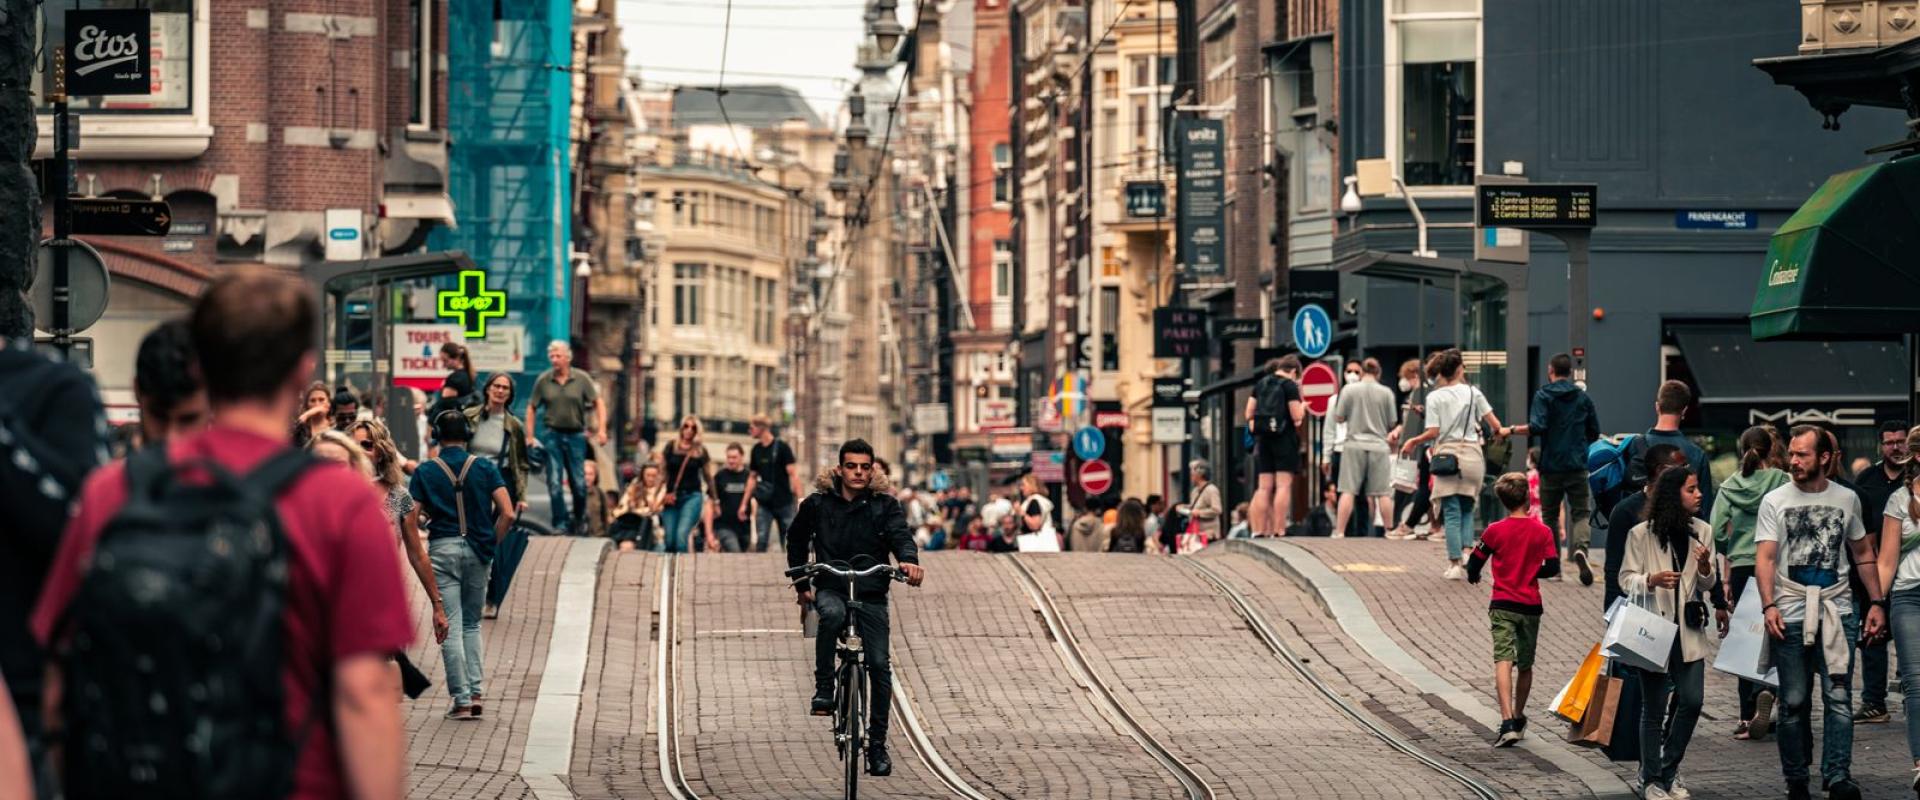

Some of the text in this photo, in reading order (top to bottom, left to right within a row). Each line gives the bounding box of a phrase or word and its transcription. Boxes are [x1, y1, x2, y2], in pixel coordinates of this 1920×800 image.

[74, 25, 139, 61] Etos
[1688, 212, 1746, 221] PRINSENGRACHT
[407, 331, 450, 343] TOURS
[402, 357, 448, 370] TICKET
[1638, 626, 1655, 641] Dior
